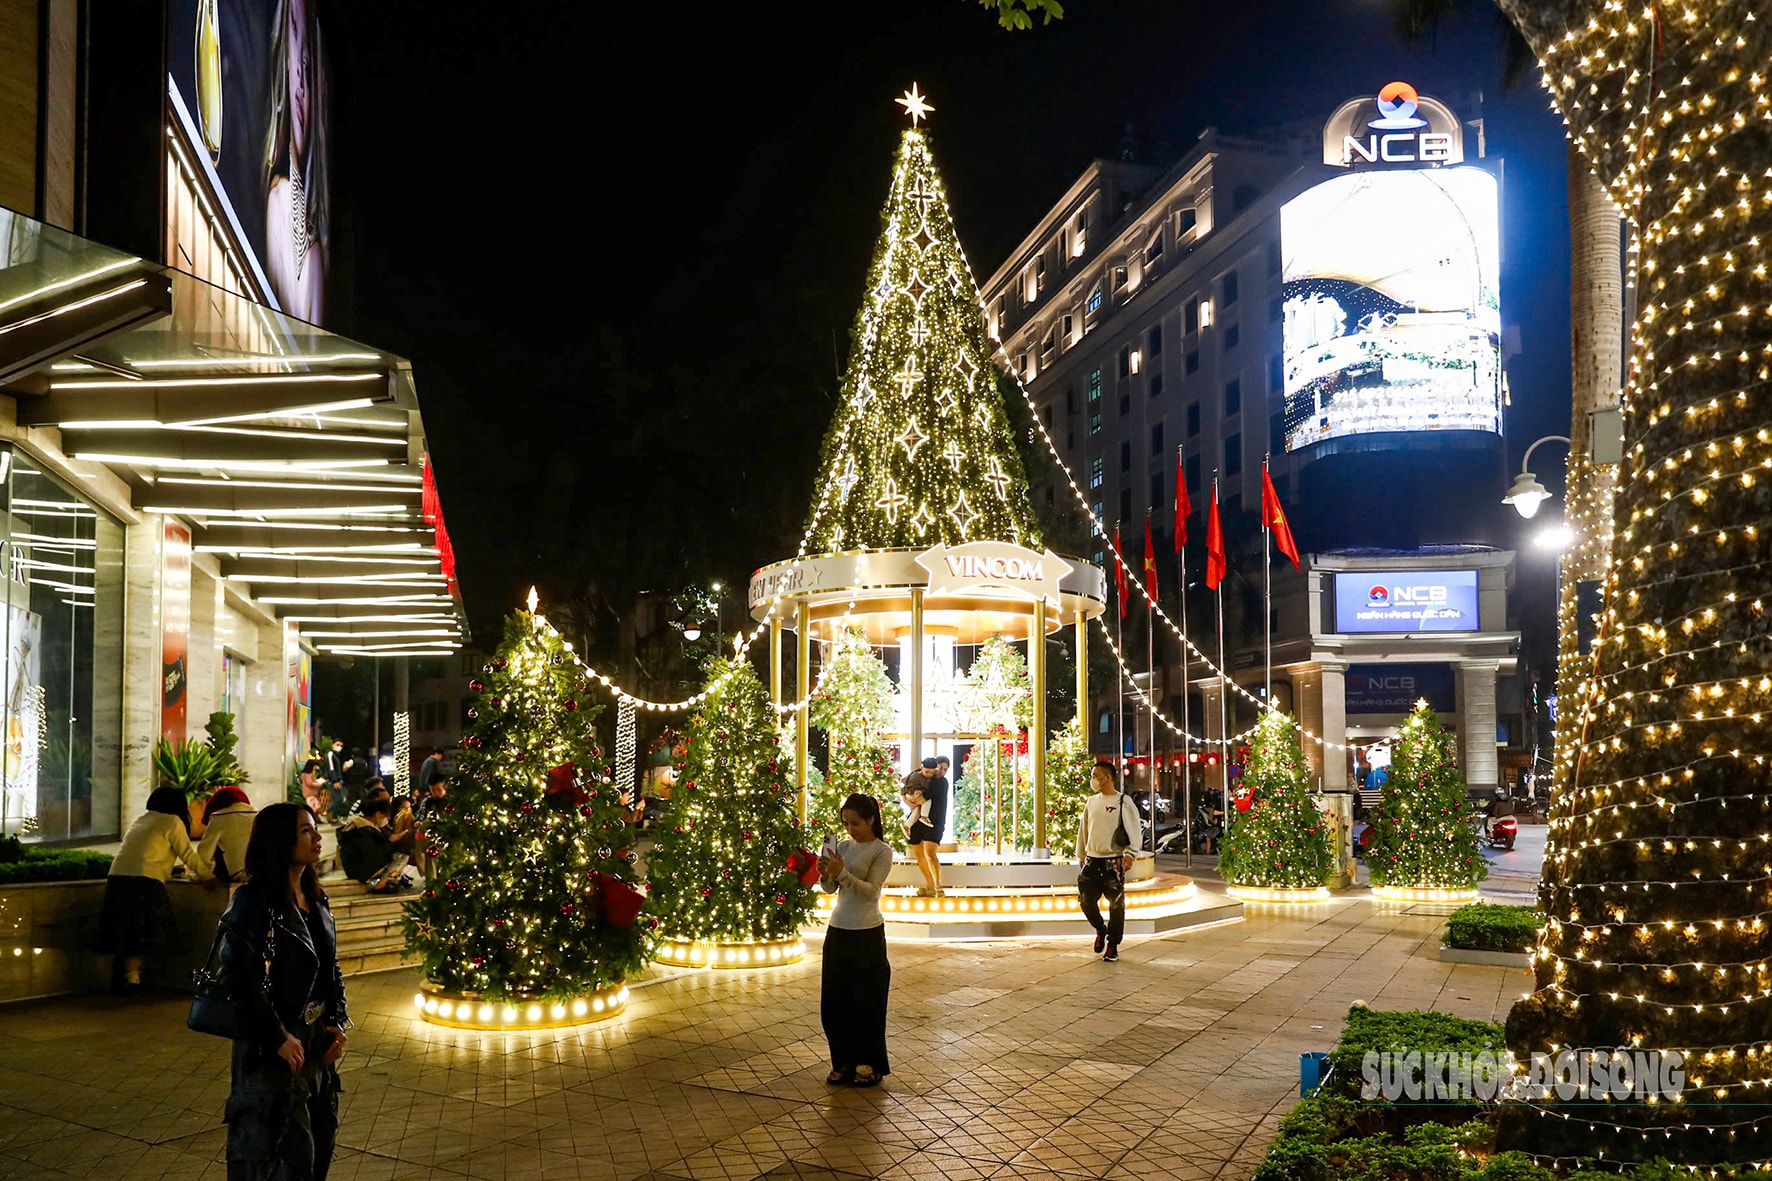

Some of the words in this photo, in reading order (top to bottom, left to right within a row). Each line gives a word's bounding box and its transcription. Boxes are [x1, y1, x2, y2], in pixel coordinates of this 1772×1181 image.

[1344, 131, 1450, 163] NCB
[944, 555, 1046, 580] VINCOM
[1393, 586, 1447, 601] NCB
[1368, 677, 1415, 690] NCB
